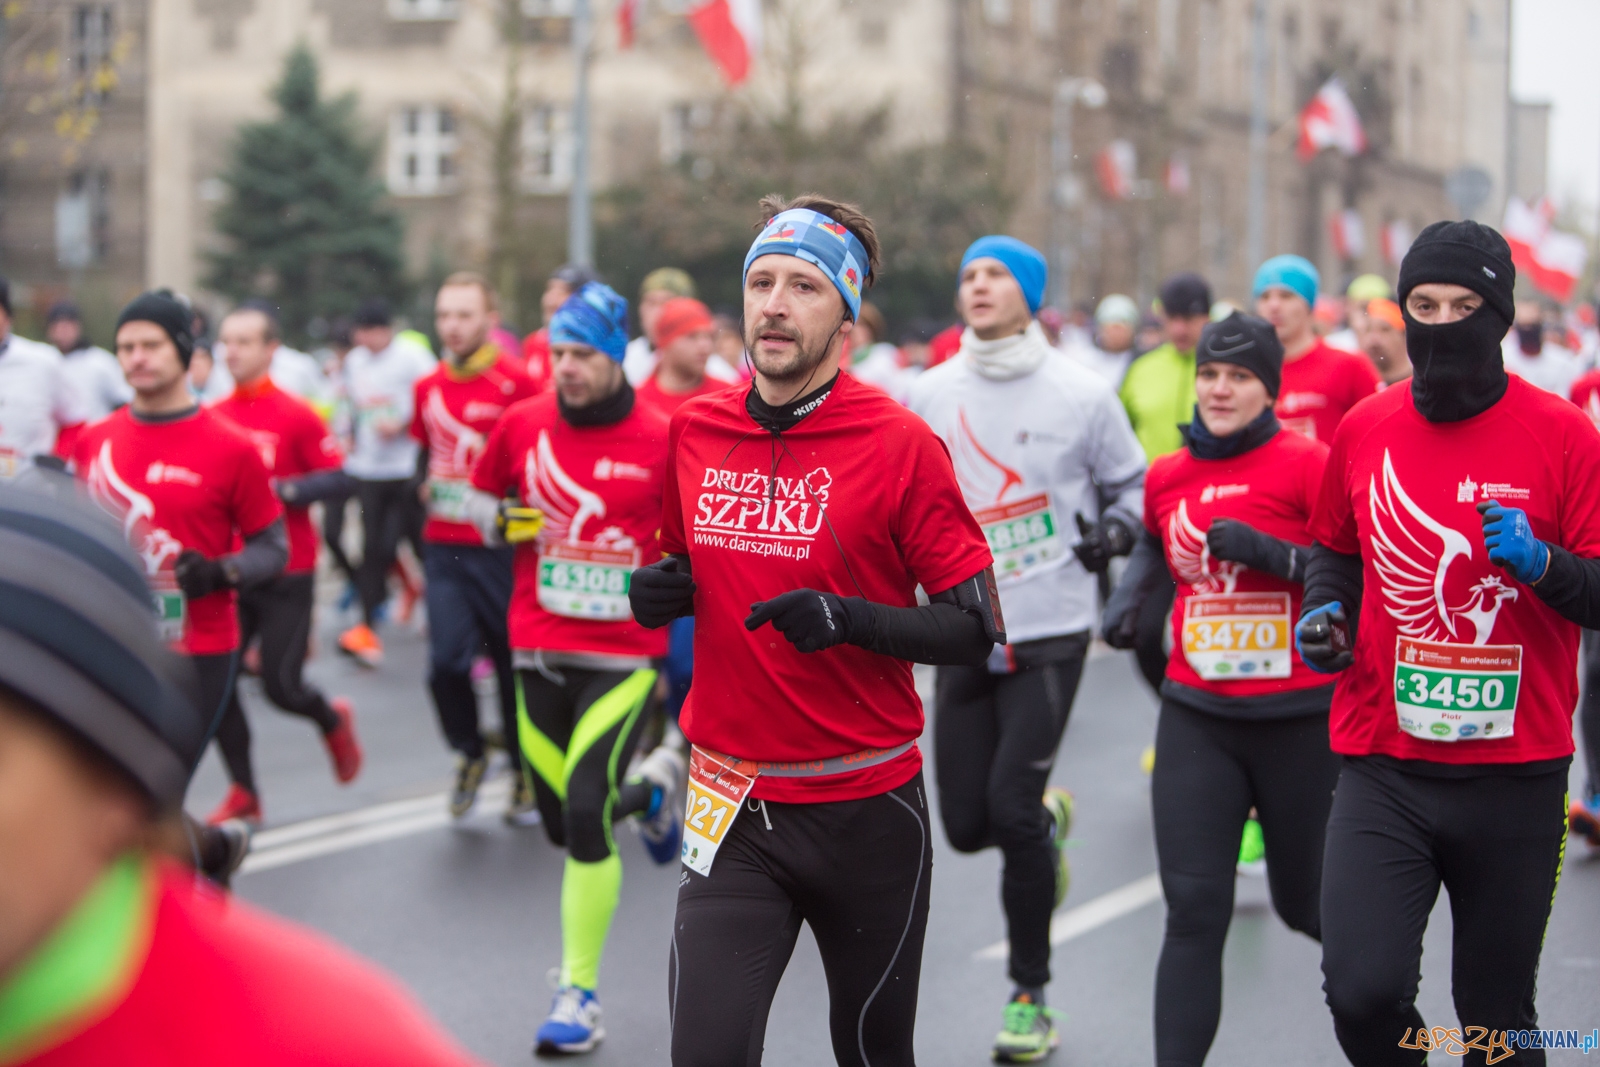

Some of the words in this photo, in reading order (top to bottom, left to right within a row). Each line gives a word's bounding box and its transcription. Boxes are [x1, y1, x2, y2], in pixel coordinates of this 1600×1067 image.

[701, 467, 807, 500] DRUŻYNA
[693, 492, 828, 535] SZPIKU
[694, 533, 810, 561] www.darszpiku.pl
[818, 595, 832, 619] asics
[1195, 621, 1278, 651] 3470
[1460, 656, 1512, 667] RunPoland.org
[1408, 672, 1505, 709] 3450
[1441, 712, 1462, 721] Piotr
[698, 766, 740, 795] RunPland.org
